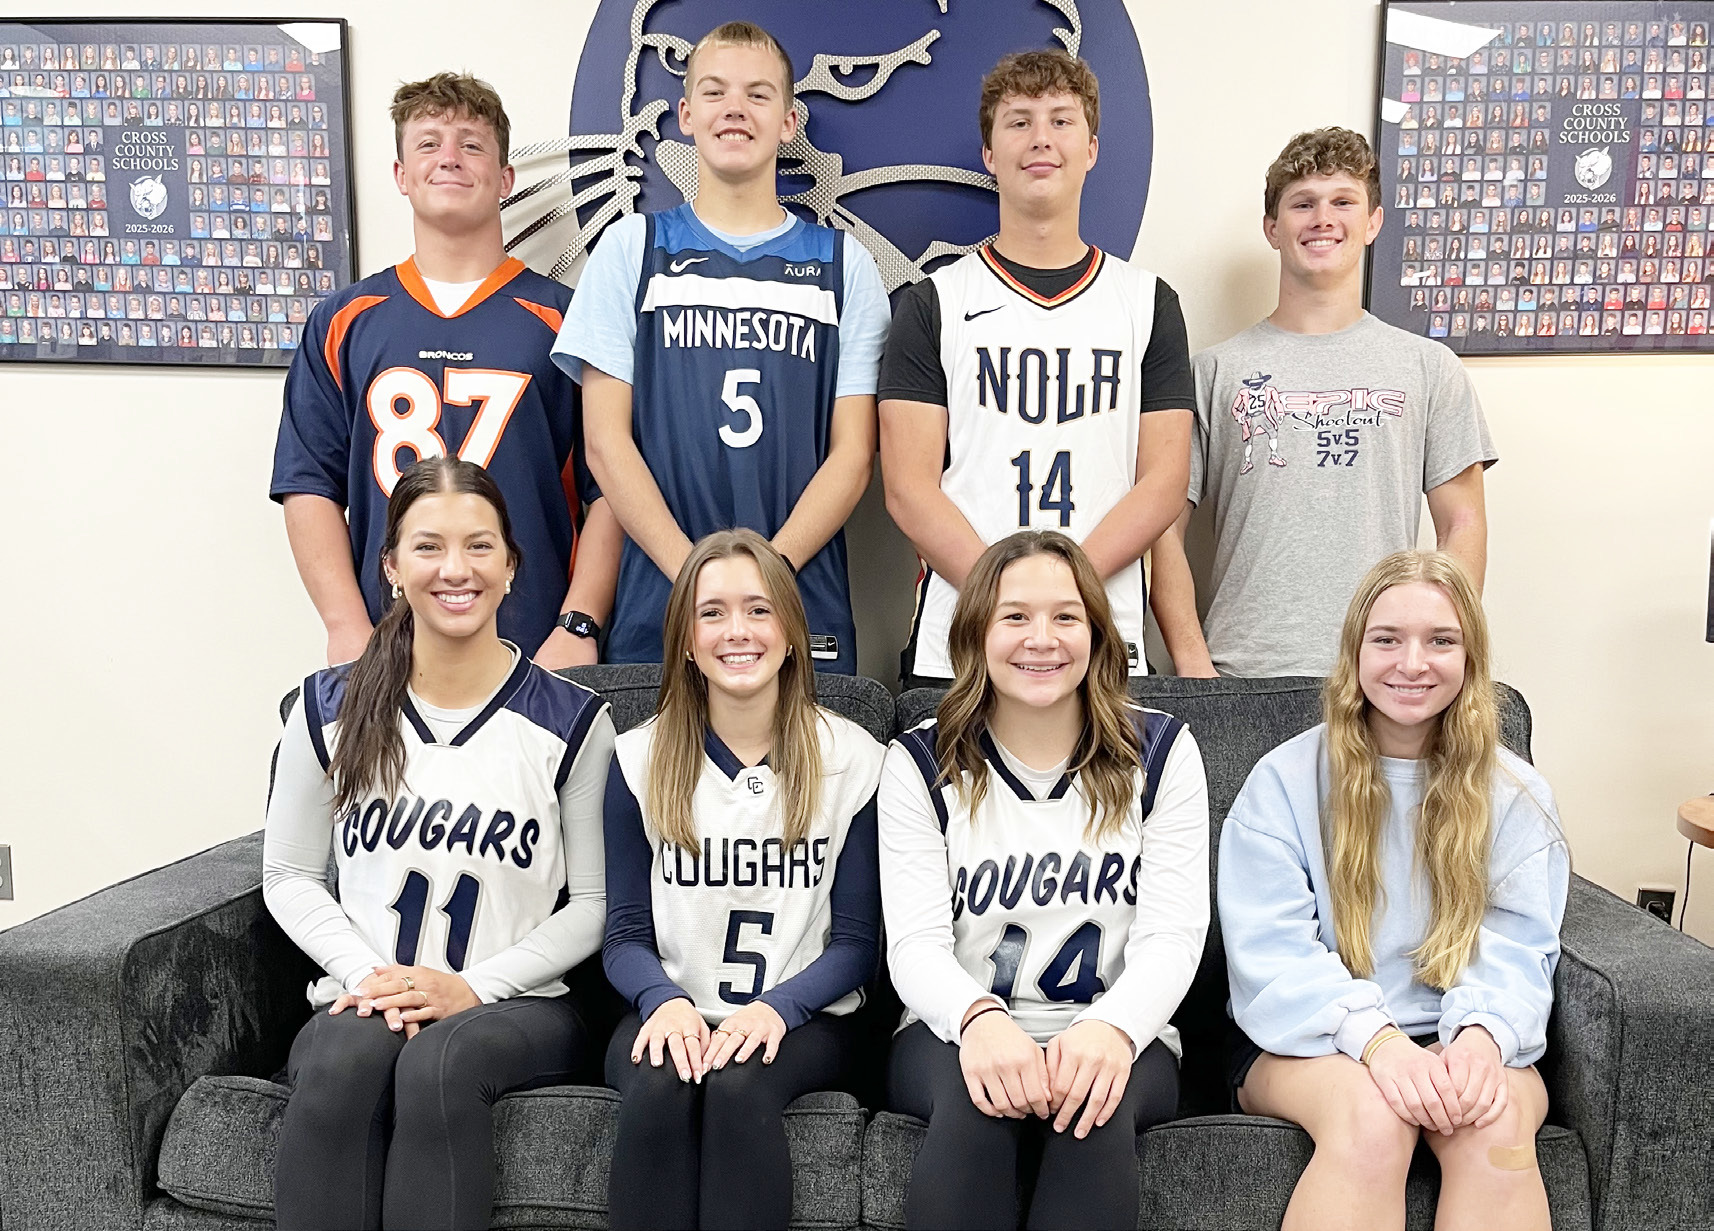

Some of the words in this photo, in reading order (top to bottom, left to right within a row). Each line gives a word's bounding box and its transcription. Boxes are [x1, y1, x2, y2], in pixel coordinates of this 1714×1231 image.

[1563, 117, 1628, 130] COUNTY
[1572, 103, 1622, 117] CROSS
[114, 144, 175, 157] COUNTY
[121, 131, 168, 144] CROSS
[1559, 130, 1631, 144] SCHOOLS
[112, 158, 179, 171] SCHOOLS
[1563, 193, 1617, 204] 2025-2026
[125, 223, 175, 234] 2025-2026
[662, 308, 817, 363] MINNESOTA
[418, 350, 474, 361] BRONCOS
[974, 346, 1124, 427] NOLA
[718, 368, 764, 448] 5
[1249, 394, 1266, 410] 25
[1278, 387, 1406, 417] EPIC
[366, 366, 533, 499] 87
[1291, 410, 1384, 431] Shootout
[1010, 448, 1075, 529] 14
[343, 796, 540, 868] COUGARS
[661, 836, 830, 888] COUGARS
[952, 849, 1142, 922] COUGARS
[385, 867, 484, 974] 11
[718, 909, 775, 1006] 5
[983, 918, 1112, 1005] 14
